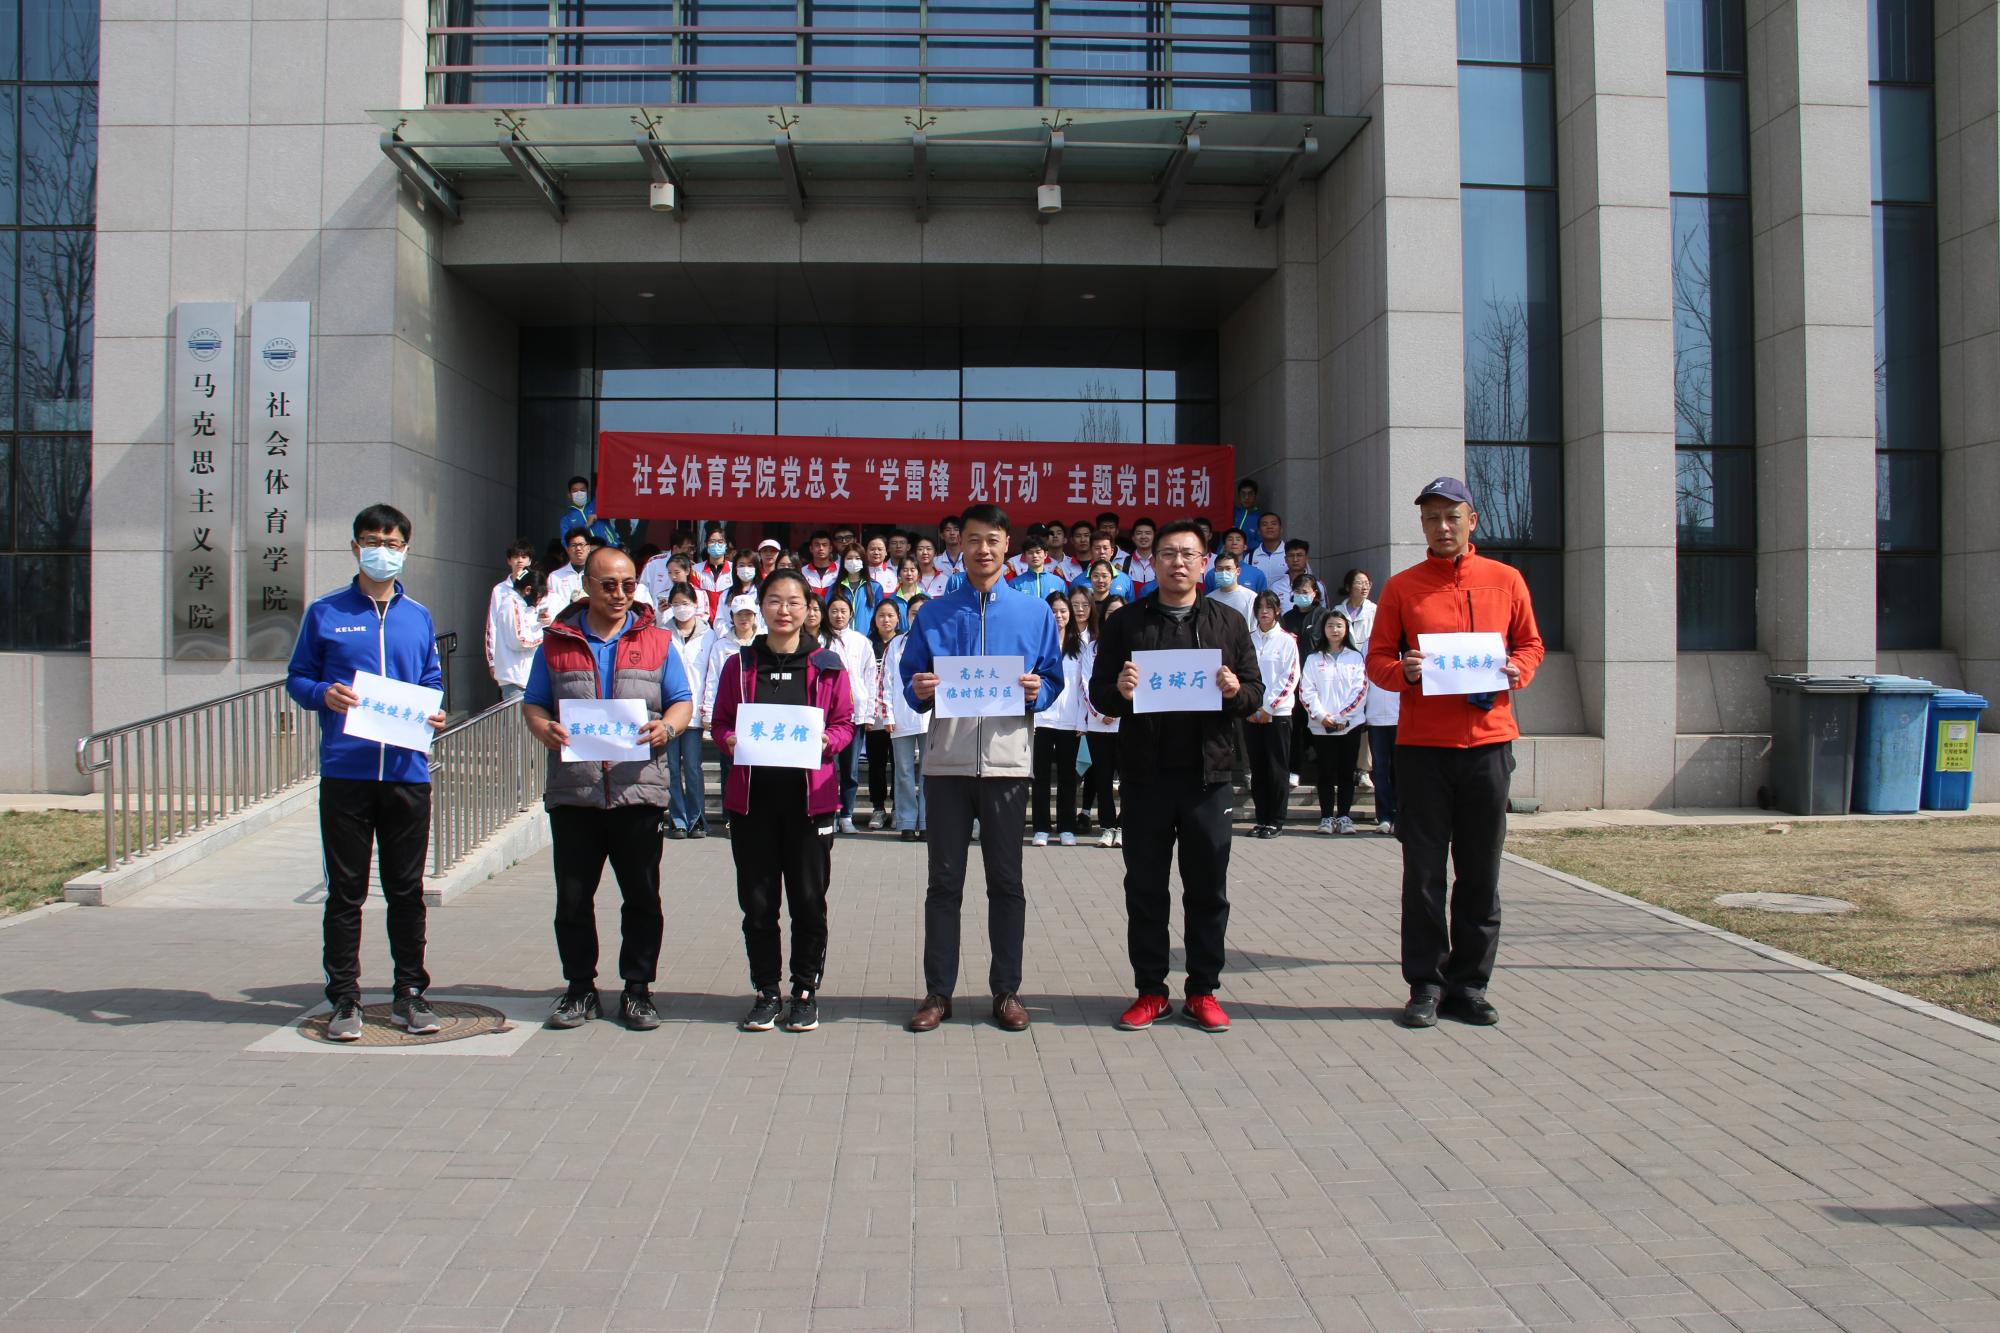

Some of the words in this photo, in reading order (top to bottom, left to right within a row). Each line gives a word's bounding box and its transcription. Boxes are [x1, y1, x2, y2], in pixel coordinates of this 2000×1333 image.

[188, 373, 216, 630] 马克思主义学院
[262, 391, 291, 611] 社会体育学院
[335, 625, 367, 633] KELME
[960, 667, 1000, 680] 高尔夫
[1149, 671, 1207, 690] 台球厅
[946, 685, 1013, 699] 临时练习区
[569, 720, 638, 736] 器械健身房
[750, 720, 810, 742] 攀岩馆
